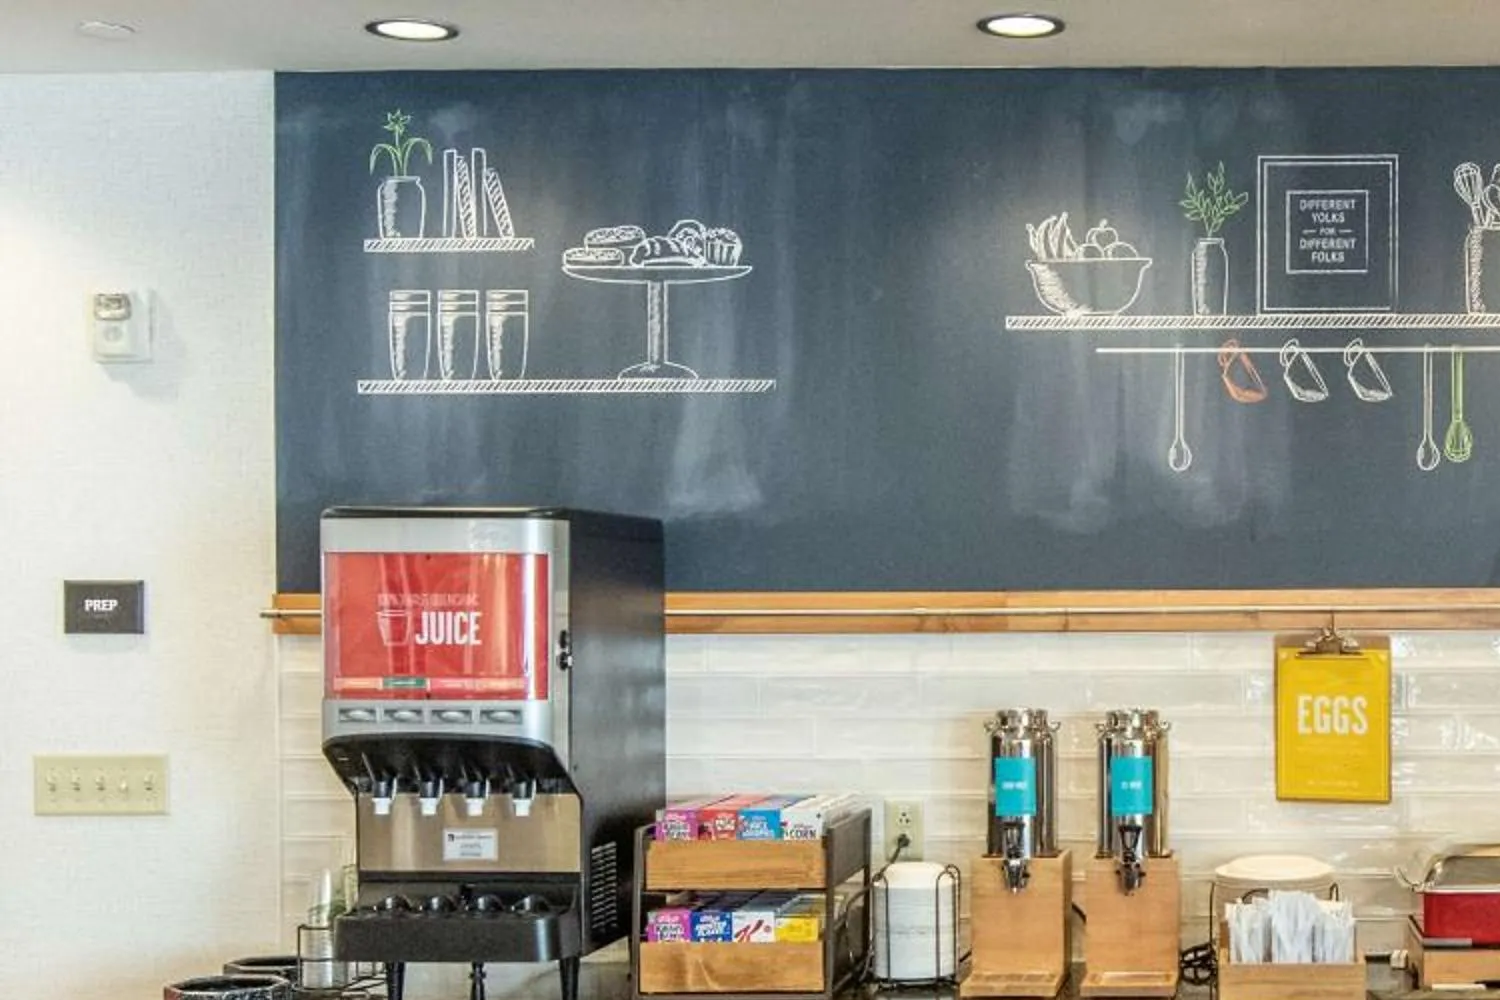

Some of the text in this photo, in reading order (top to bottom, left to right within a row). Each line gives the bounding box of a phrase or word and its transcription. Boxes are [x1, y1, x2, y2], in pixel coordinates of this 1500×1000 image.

[1299, 199, 1356, 211] DIFFERENT
[1311, 211, 1345, 223] YOLKS
[1299, 238, 1357, 250] DIFFERENT
[1311, 251, 1345, 263] FOLKS
[84, 599, 119, 612] PREP
[415, 611, 483, 646] JUICE
[1296, 694, 1369, 737] EGGS
